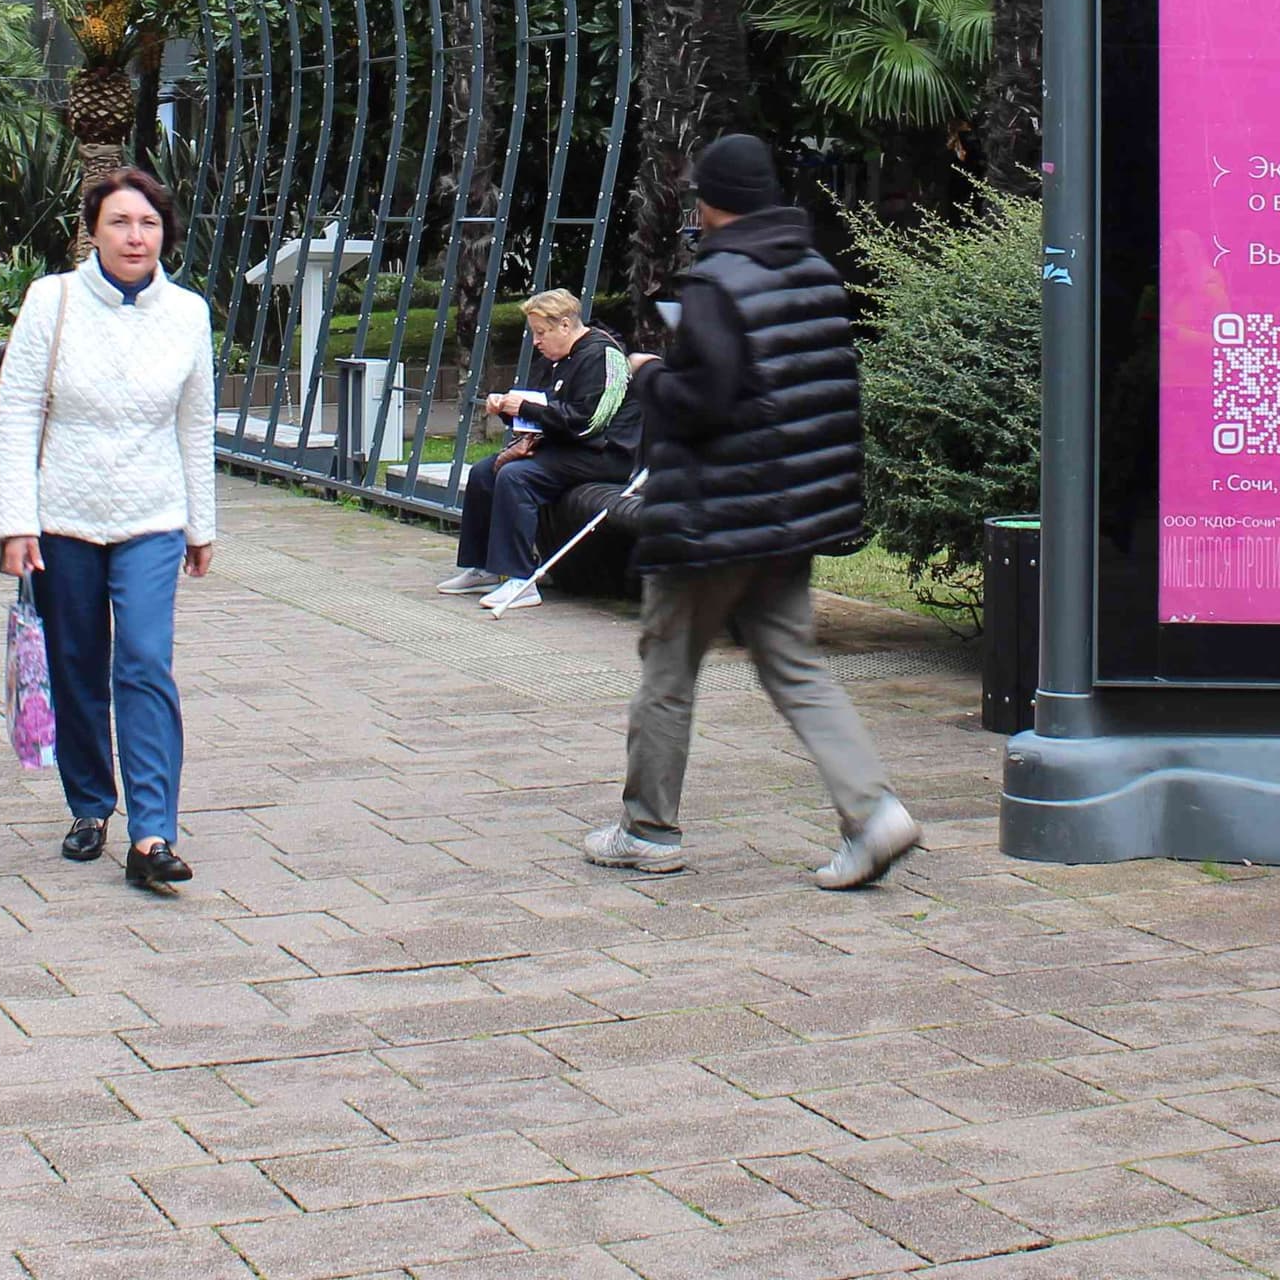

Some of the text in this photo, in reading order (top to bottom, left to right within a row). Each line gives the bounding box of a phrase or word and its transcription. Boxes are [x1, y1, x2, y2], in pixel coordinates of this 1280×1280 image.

[1248, 194, 1266, 211] о
[1227, 474, 1278, 494] Сочи,
[1163, 515, 1197, 528] ООО
[1164, 536, 1233, 589] ИМЕЮТСЯ
